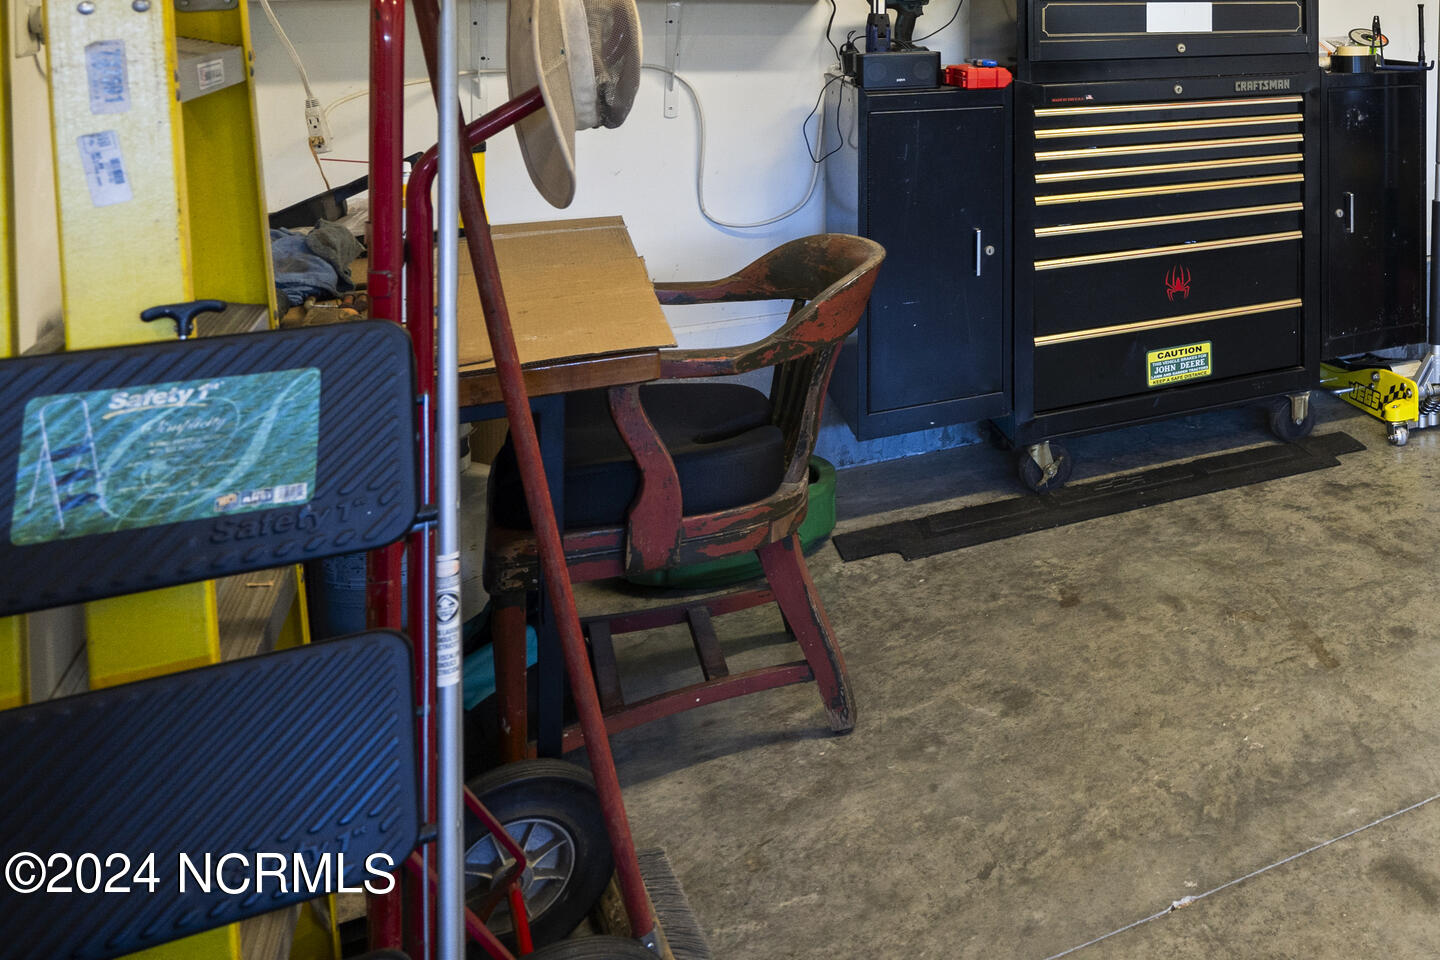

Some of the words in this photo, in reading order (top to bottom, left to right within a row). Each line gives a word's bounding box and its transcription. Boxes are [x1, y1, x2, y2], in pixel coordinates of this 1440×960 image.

[1235, 79, 1290, 92] CRAFTSMAN
[1157, 346, 1202, 359] CAUTION
[1154, 364, 1176, 374] JOHN
[1180, 359, 1206, 369] DEERE
[1184, 371, 1208, 379] DISTANCE
[108, 386, 195, 410] Safety
[1348, 381, 1381, 411] JEGS
